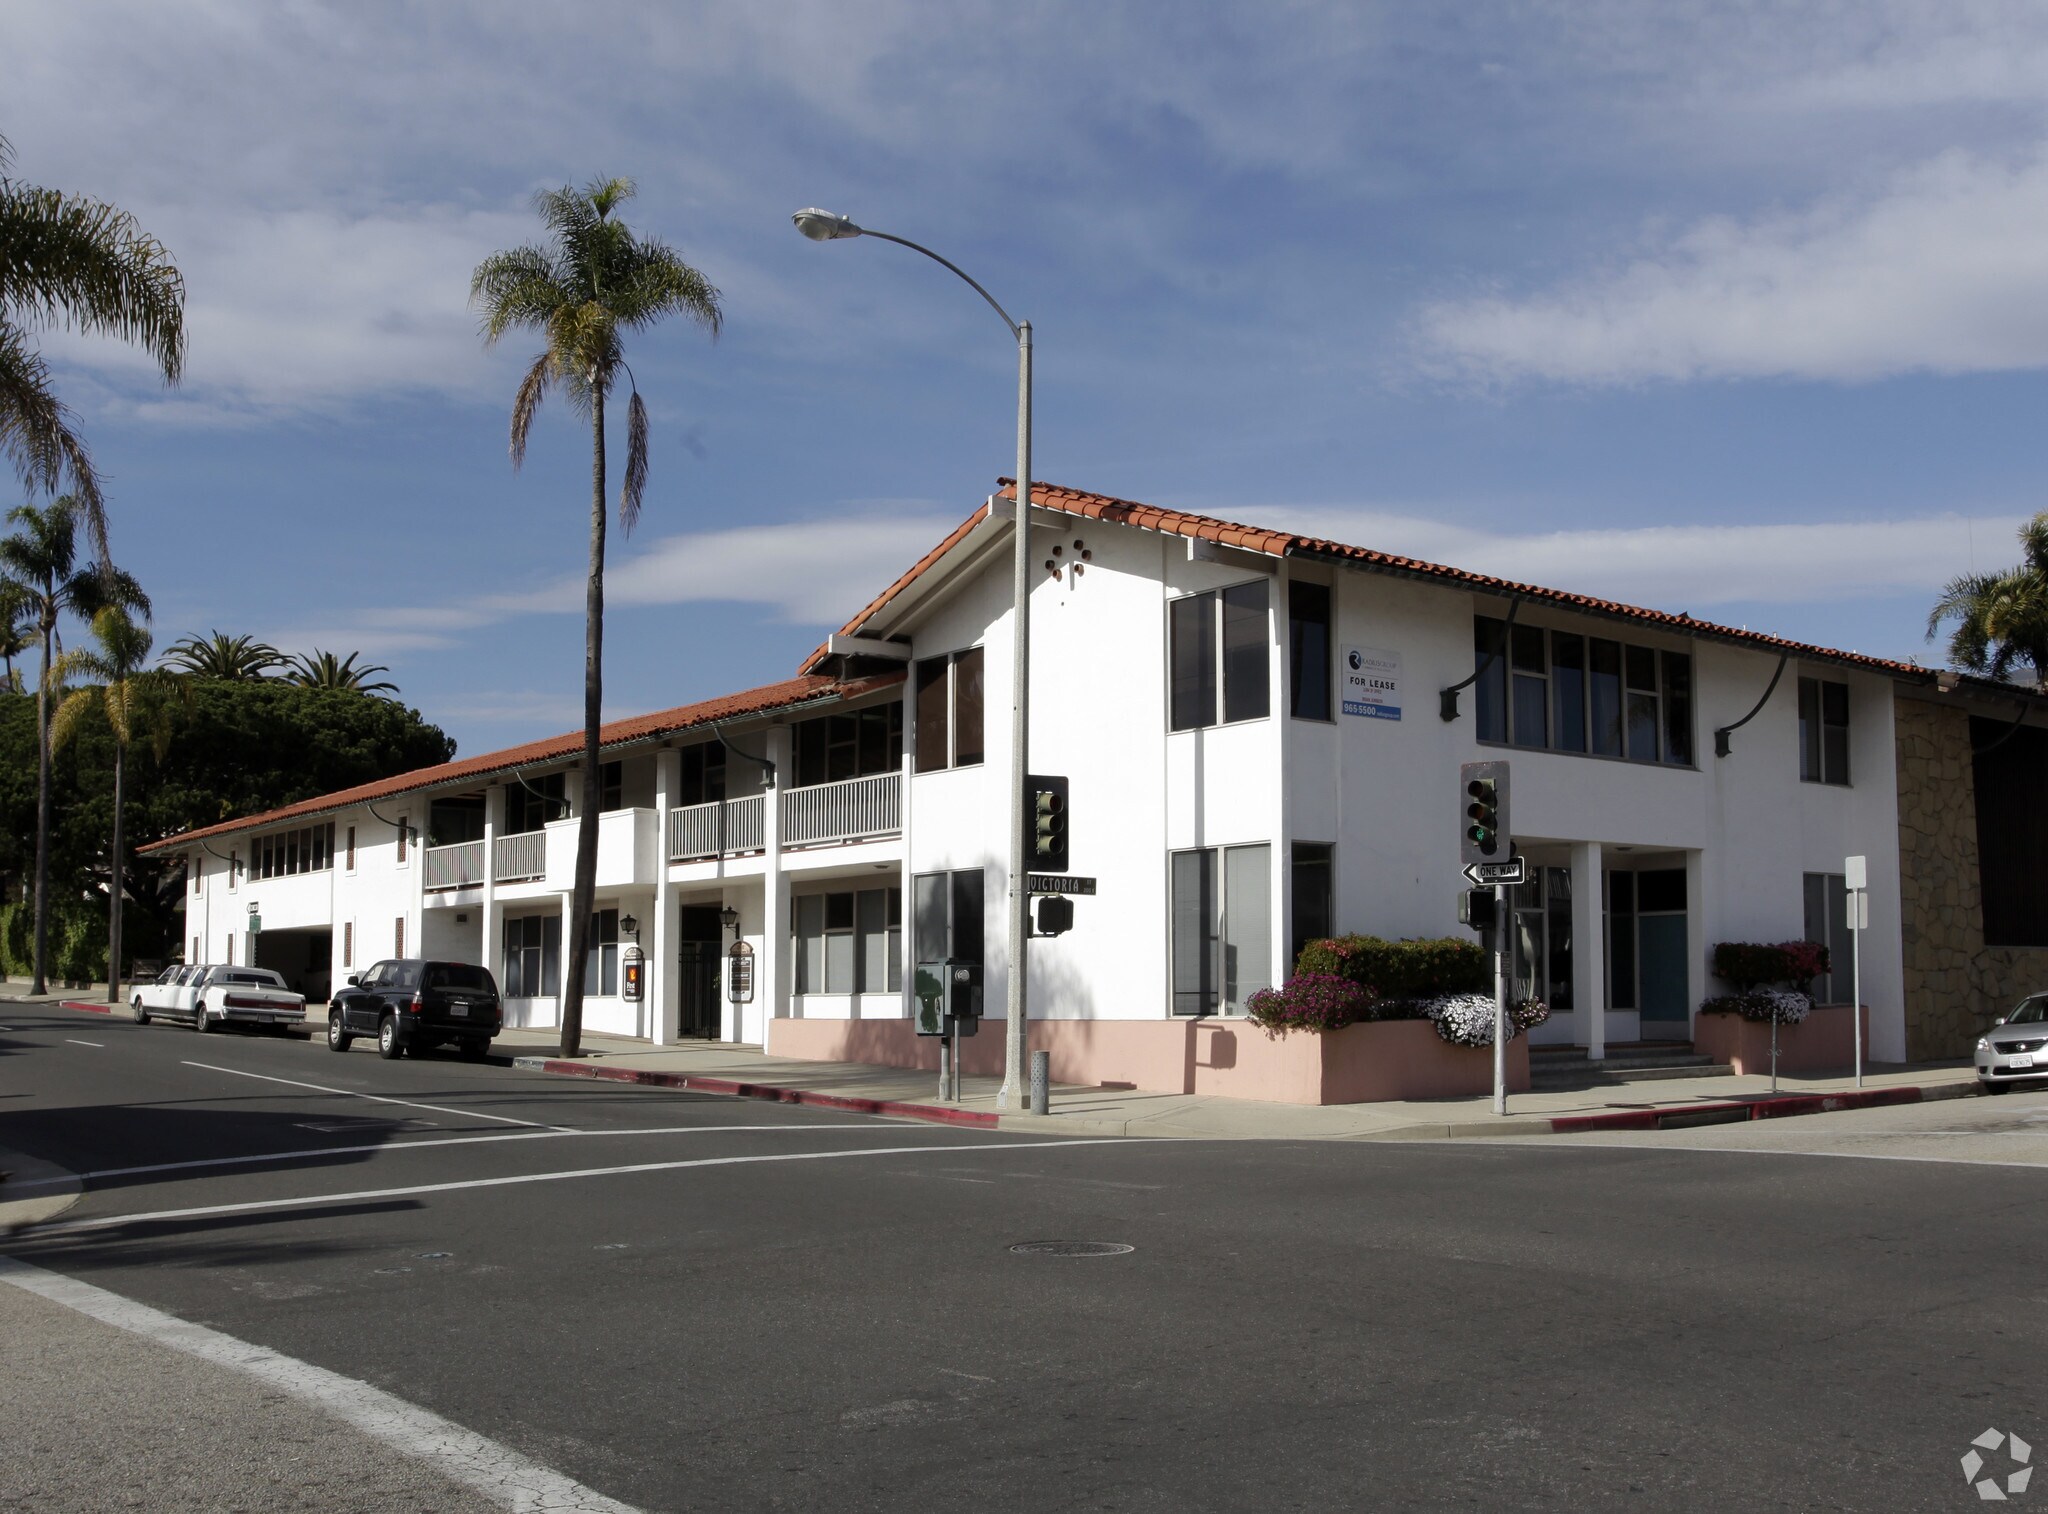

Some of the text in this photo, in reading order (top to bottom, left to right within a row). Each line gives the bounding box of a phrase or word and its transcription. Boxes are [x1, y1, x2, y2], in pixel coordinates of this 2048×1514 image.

[1350, 676, 1395, 690] FOR LEASE
[1480, 865, 1517, 876] ONE WAY
[1030, 877, 1079, 891] VICTORIA
